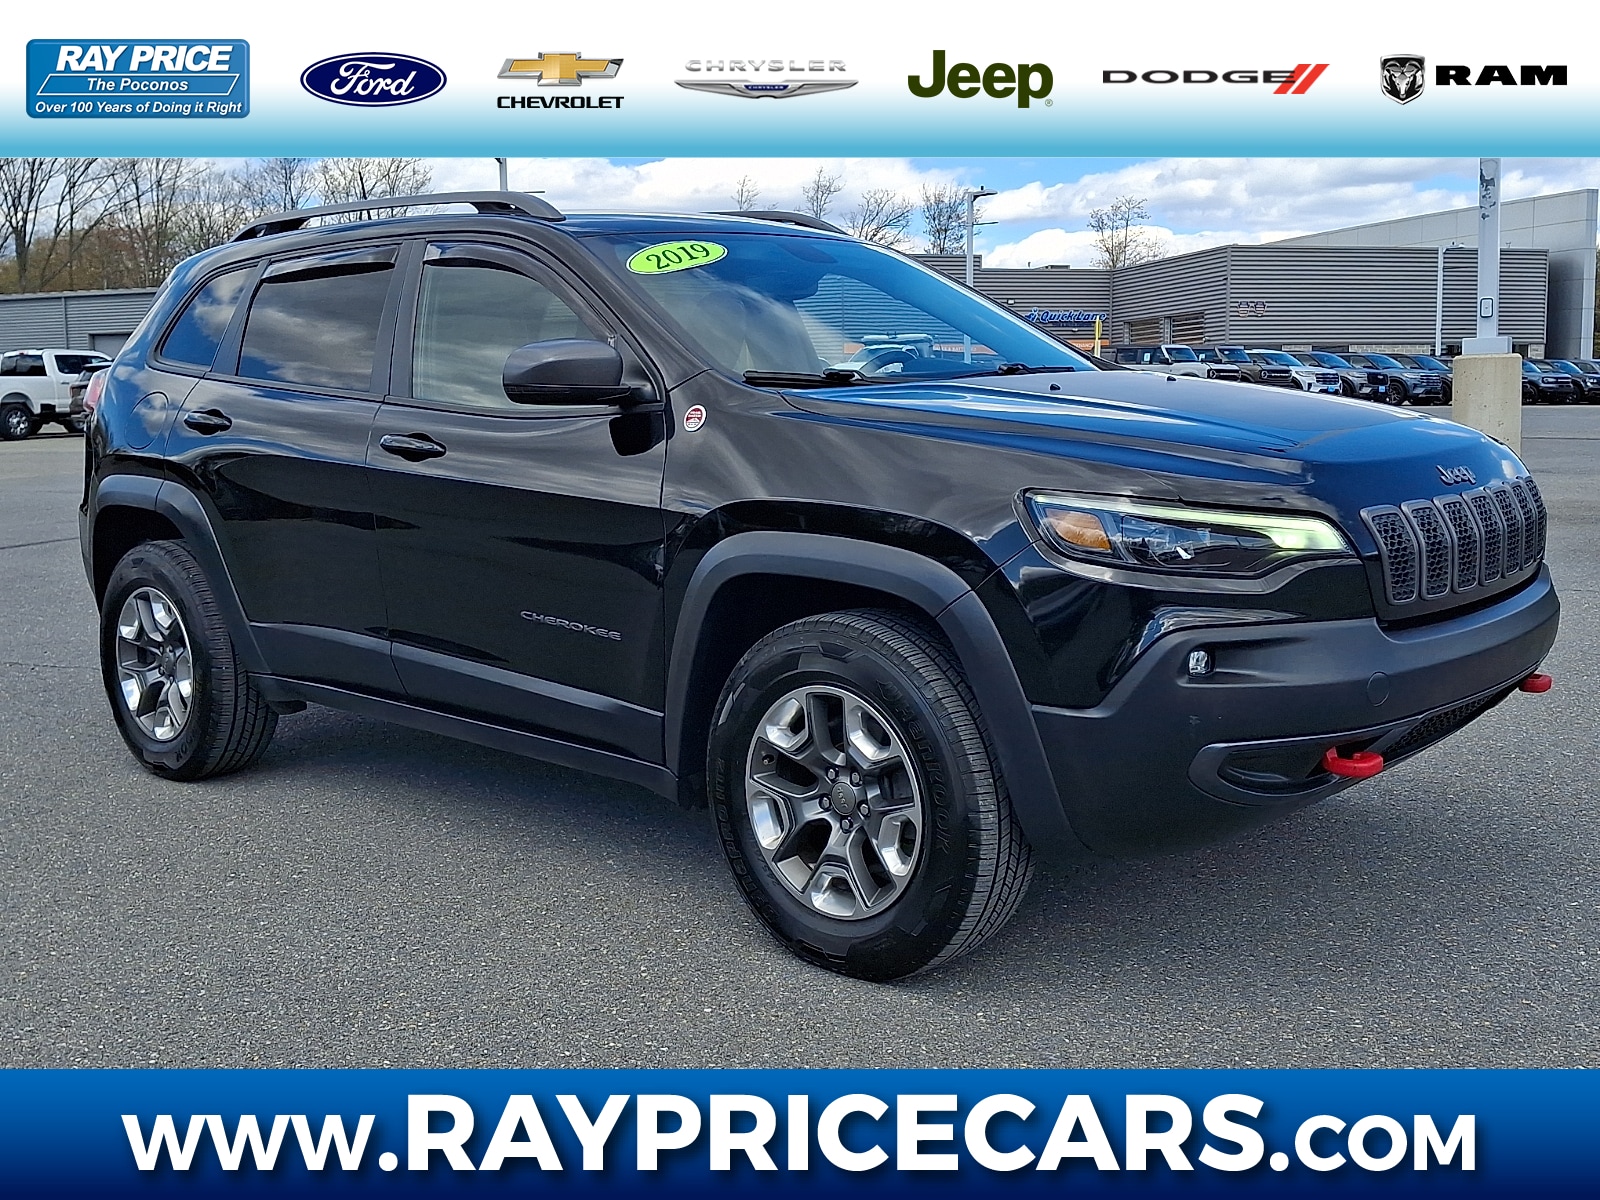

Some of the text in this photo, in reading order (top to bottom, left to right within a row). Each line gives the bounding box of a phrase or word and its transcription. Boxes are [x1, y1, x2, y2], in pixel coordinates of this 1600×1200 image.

[645, 243, 710, 270] 2019
[1040, 309, 1075, 323] Quick
[1436, 464, 1476, 485] Jeep
[520, 610, 622, 641] CHEROKEE
